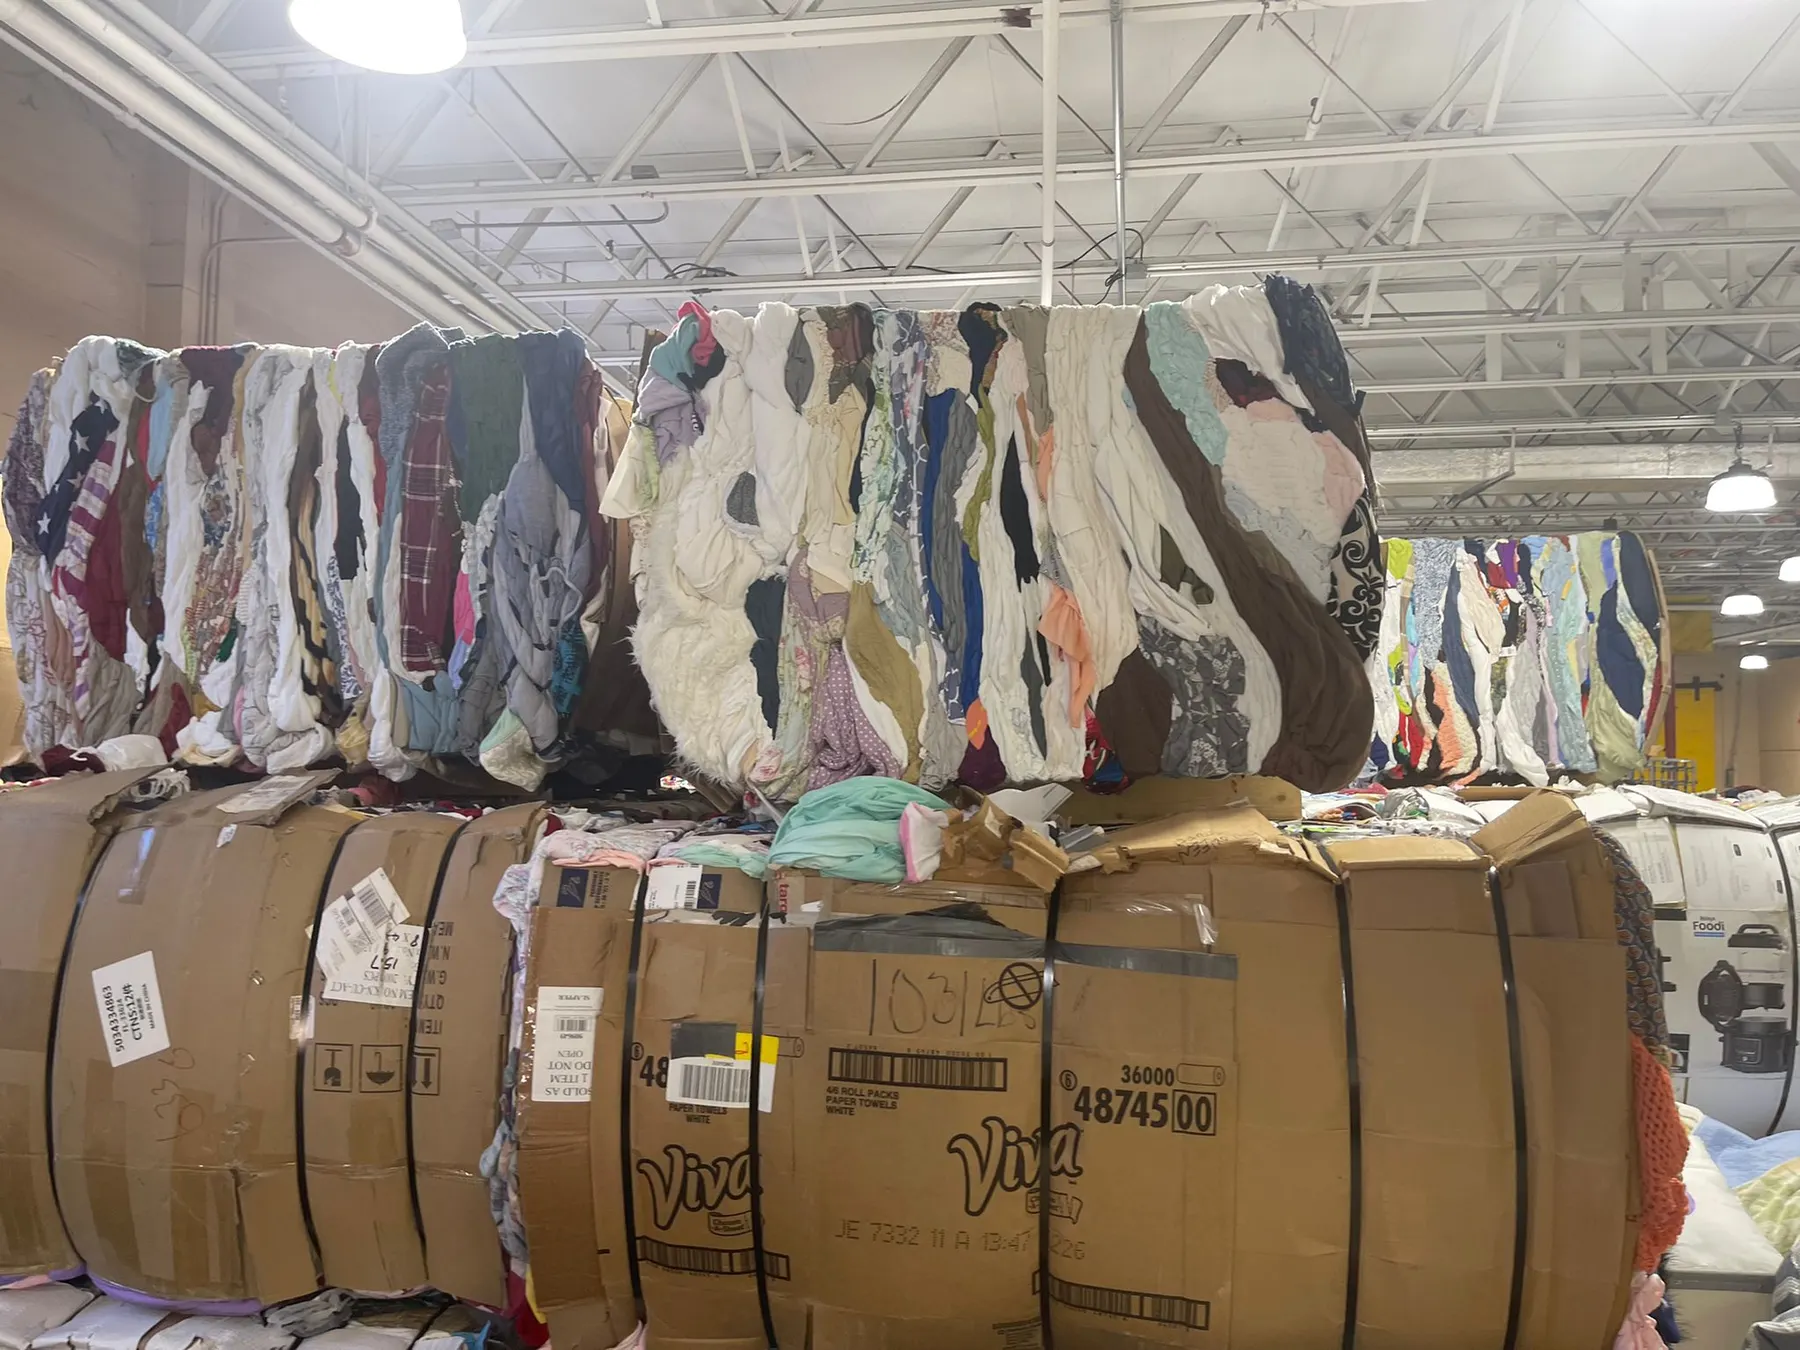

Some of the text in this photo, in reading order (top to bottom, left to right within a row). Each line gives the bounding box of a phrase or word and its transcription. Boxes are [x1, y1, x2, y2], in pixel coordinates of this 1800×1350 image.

[1693, 920, 1725, 931] Foodi
[102, 985, 125, 1053] 5034334863
[558, 1049, 584, 1058] OPEN
[548, 1061, 592, 1070] DO NOT
[639, 1055, 669, 1088] 48
[550, 1074, 579, 1083] ITEM
[1121, 1064, 1175, 1087] 36000
[545, 1087, 560, 1096] AS
[841, 1087, 865, 1097] ROLL
[867, 1089, 900, 1100] PACKS
[826, 1095, 898, 1109] PAPER TOWELS
[826, 1105, 855, 1116] WHITE
[1074, 1086, 1212, 1132] 48745 00
[686, 1114, 711, 1124] WHITE
[947, 1116, 1084, 1217] Viva
[636, 1144, 764, 1230] Viva
[870, 1222, 920, 1246] 7332
